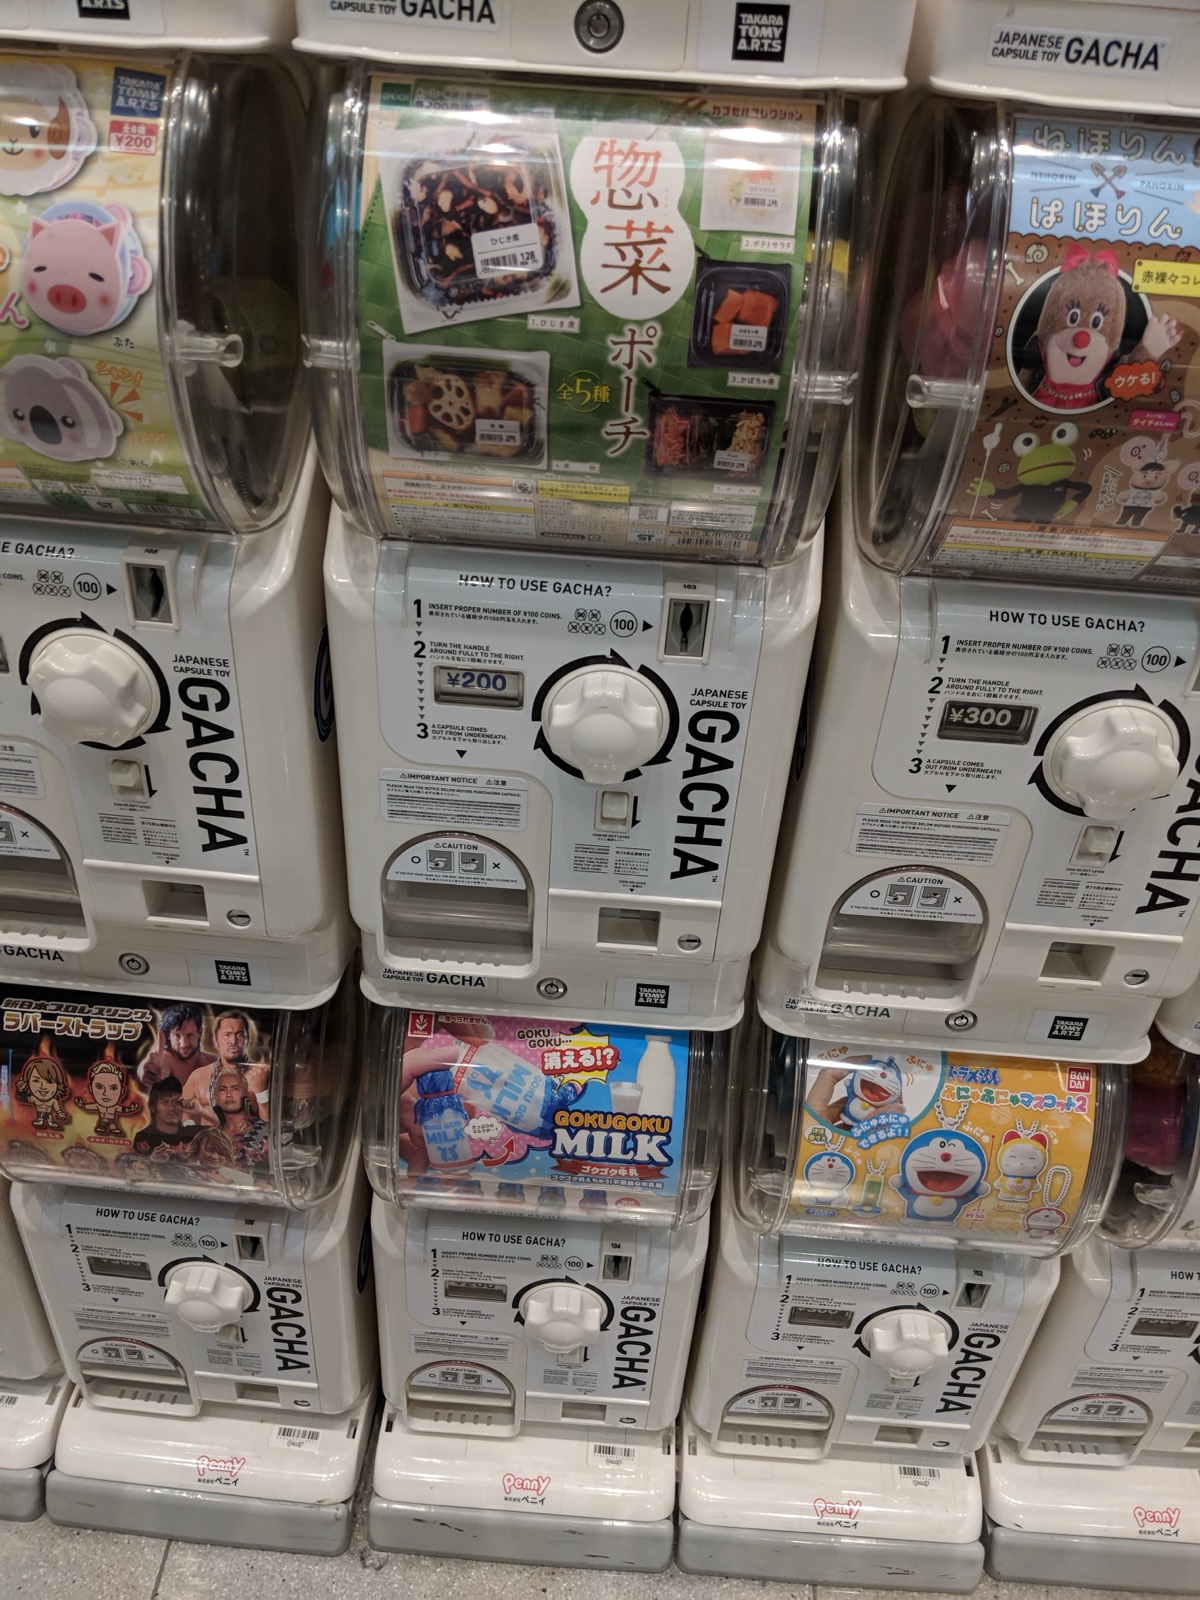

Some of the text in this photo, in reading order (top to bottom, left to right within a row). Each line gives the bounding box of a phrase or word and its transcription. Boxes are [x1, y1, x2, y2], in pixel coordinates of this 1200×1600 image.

[330, 1, 397, 15] CAPSULE TOY
[400, 0, 496, 24] GACHA
[740, 13, 783, 26] TAKARA
[739, 25, 783, 40] TOMY
[994, 31, 1064, 49] JAPANESE
[991, 47, 1061, 63] CAPSULE TOY
[119, 76, 161, 90] TAKARA
[118, 86, 159, 100] TOMY
[116, 135, 152, 148] ¥200
[1033, 125, 1185, 164] ねほりん
[1030, 171, 1076, 182] NEHORIN
[1140, 180, 1185, 191] PAHORIN
[1030, 197, 1183, 239] ぱほりん
[590, 138, 674, 455] 惣菜 ポーチ
[114, 337, 134, 349] ぶた
[557, 378, 610, 406] 全5種
[15, 542, 75, 560] GACHA?
[77, 581, 98, 594] 100
[459, 574, 612, 597] HOW TO USE GACHA?
[414, 599, 422, 618] 1
[429, 603, 453, 611] INSERT
[454, 605, 481, 613] PROPER
[483, 607, 511, 615] NUMBER
[523, 610, 539, 618] ¥100
[540, 611, 562, 619] COINS.
[613, 619, 633, 631] 100
[989, 610, 1145, 632] HOW TO USE GACHA?
[414, 641, 426, 658] 2
[941, 635, 950, 654] 1
[956, 639, 981, 647] INSERT
[983, 641, 1010, 649] PROPER
[1071, 647, 1093, 655] COINS.
[172, 654, 230, 668] JAPANESE
[458, 649, 479, 657] FULLY
[1146, 654, 1167, 666] 100
[173, 665, 231, 678] CAPSULE TOY
[447, 672, 507, 691] ¥200
[928, 677, 943, 693] 2
[691, 688, 748, 700] JAPANESE
[689, 699, 747, 710] CAPSULE TOY
[949, 707, 1011, 726] ¥300
[417, 722, 429, 739] 3
[464, 732, 508, 740] UNDERNEATH.
[178, 677, 248, 852] GACHA
[909, 758, 922, 773] 3
[407, 774, 450, 782] IMPORTANT
[670, 710, 740, 880] GACHA
[886, 808, 959, 819] IMPORTANT NOTICE
[906, 877, 944, 885] CAUTION
[4, 945, 65, 962] GACHA
[382, 974, 410, 982] CAPSULE
[426, 972, 485, 988] GACHA
[4, 1012, 141, 1040] ラバーストラップ
[1054, 1024, 1083, 1032] TOMY
[1055, 1019, 1084, 1027] TAKARA
[517, 1029, 550, 1040] GOKU
[906, 1055, 933, 1071] ふにゅ
[1069, 1080, 1085, 1089] DAI
[1070, 1072, 1089, 1081] BAN
[491, 1063, 532, 1122] MILK
[554, 1110, 670, 1133] GOKUGOKU
[552, 1128, 669, 1163] MILK
[96, 1208, 200, 1226] HOW TO USE GACHA?
[201, 1240, 216, 1248] 100
[462, 1231, 566, 1247] HOW TO USE GACHA?
[817, 1258, 922, 1275] HOW TO USE GACHA?
[264, 1276, 302, 1284] JAPANESE
[1170, 1271, 1194, 1280] HOW
[921, 1287, 938, 1296] 100
[266, 1287, 311, 1371] GACHA
[969, 1322, 1010, 1330] JAPANESE
[613, 1306, 656, 1389] GACHA
[935, 1333, 1001, 1414] GACHA
[196, 1455, 246, 1477] Penny
[502, 1473, 551, 1496] Penny
[1133, 1506, 1181, 1528] Penny
